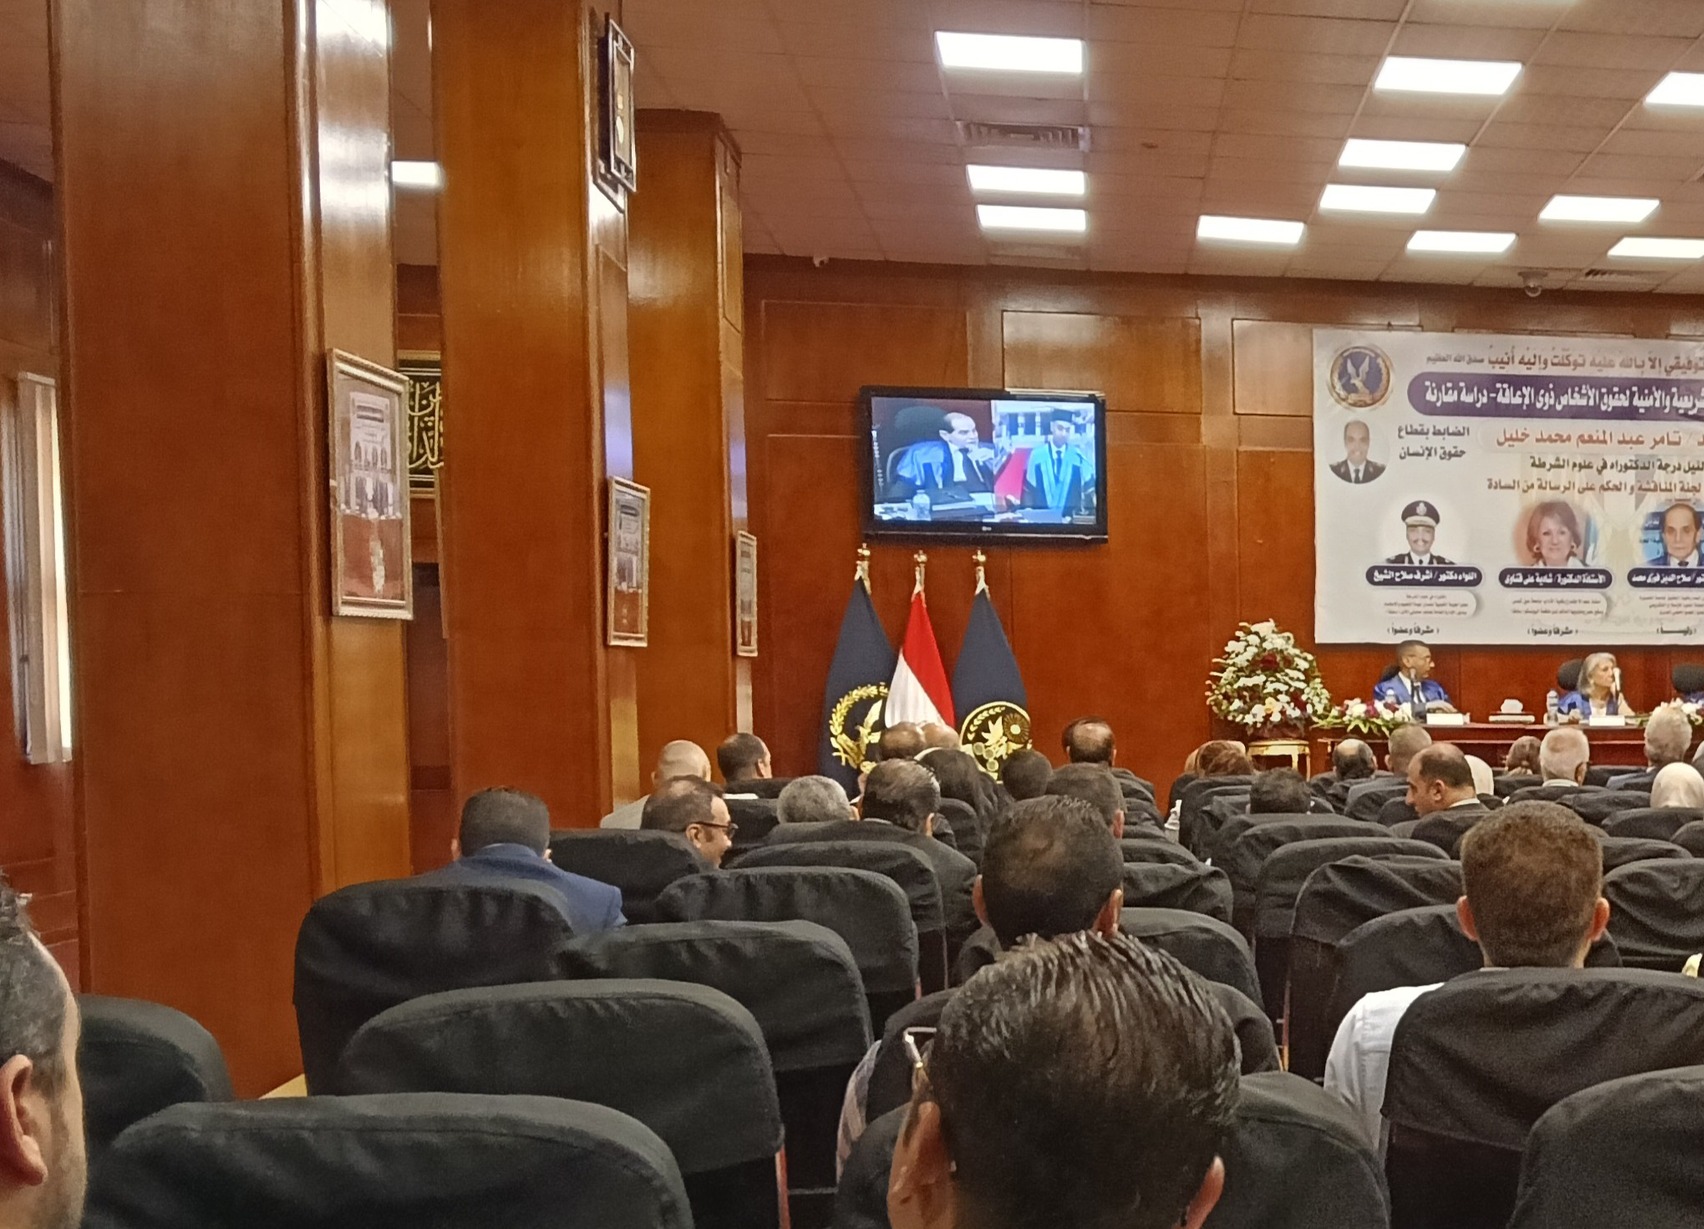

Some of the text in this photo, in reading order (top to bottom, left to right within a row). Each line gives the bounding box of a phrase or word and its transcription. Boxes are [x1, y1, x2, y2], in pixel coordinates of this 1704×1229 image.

[1424, 380, 1458, 408] مقارنة
[1459, 381, 1488, 408] دراسة
[1555, 384, 1599, 411] الأشخاص
[1600, 386, 1630, 412] لحقوق
[1631, 386, 1671, 413] والأمنية
[1397, 424, 1470, 441] الضابط بقطاع
[1496, 427, 1530, 448] خليل
[1535, 429, 1572, 443] محمد
[1576, 429, 1613, 447] المنعم
[1649, 430, 1682, 450] تامر
[1617, 432, 1645, 450] عبد
[1398, 446, 1467, 461] حقوق الإنسان
[1529, 455, 1569, 472] الشرطة
[1571, 458, 1594, 472] علوم
[1609, 458, 1655, 473] الدكتوراه
[1657, 458, 1682, 473] درجة
[1683, 460, 1704, 474] لنيل
[1486, 477, 1521, 491] السادة
[1521, 481, 1535, 494] من
[1537, 479, 1576, 494] الرسالة
[1637, 480, 1677, 493] المناقشة
[1679, 481, 1701, 496] لجنة
